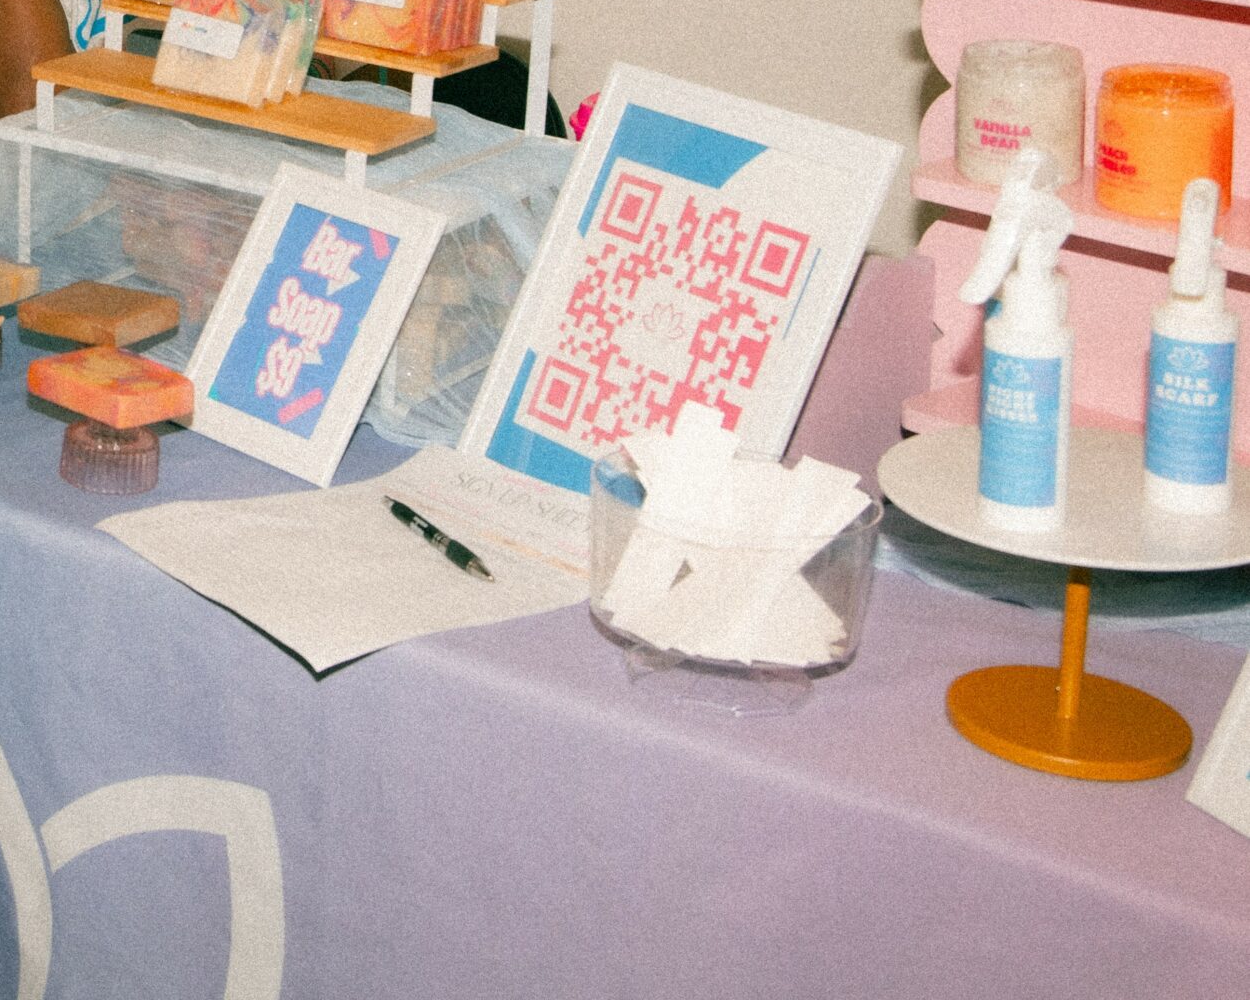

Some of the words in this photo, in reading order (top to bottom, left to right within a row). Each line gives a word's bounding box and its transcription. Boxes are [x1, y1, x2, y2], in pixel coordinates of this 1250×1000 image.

[302, 221, 365, 281] Bar
[267, 276, 342, 347] Soap
[255, 336, 304, 398] $9
[1155, 385, 1219, 407] SCARF
[1163, 372, 1211, 392] SILK
